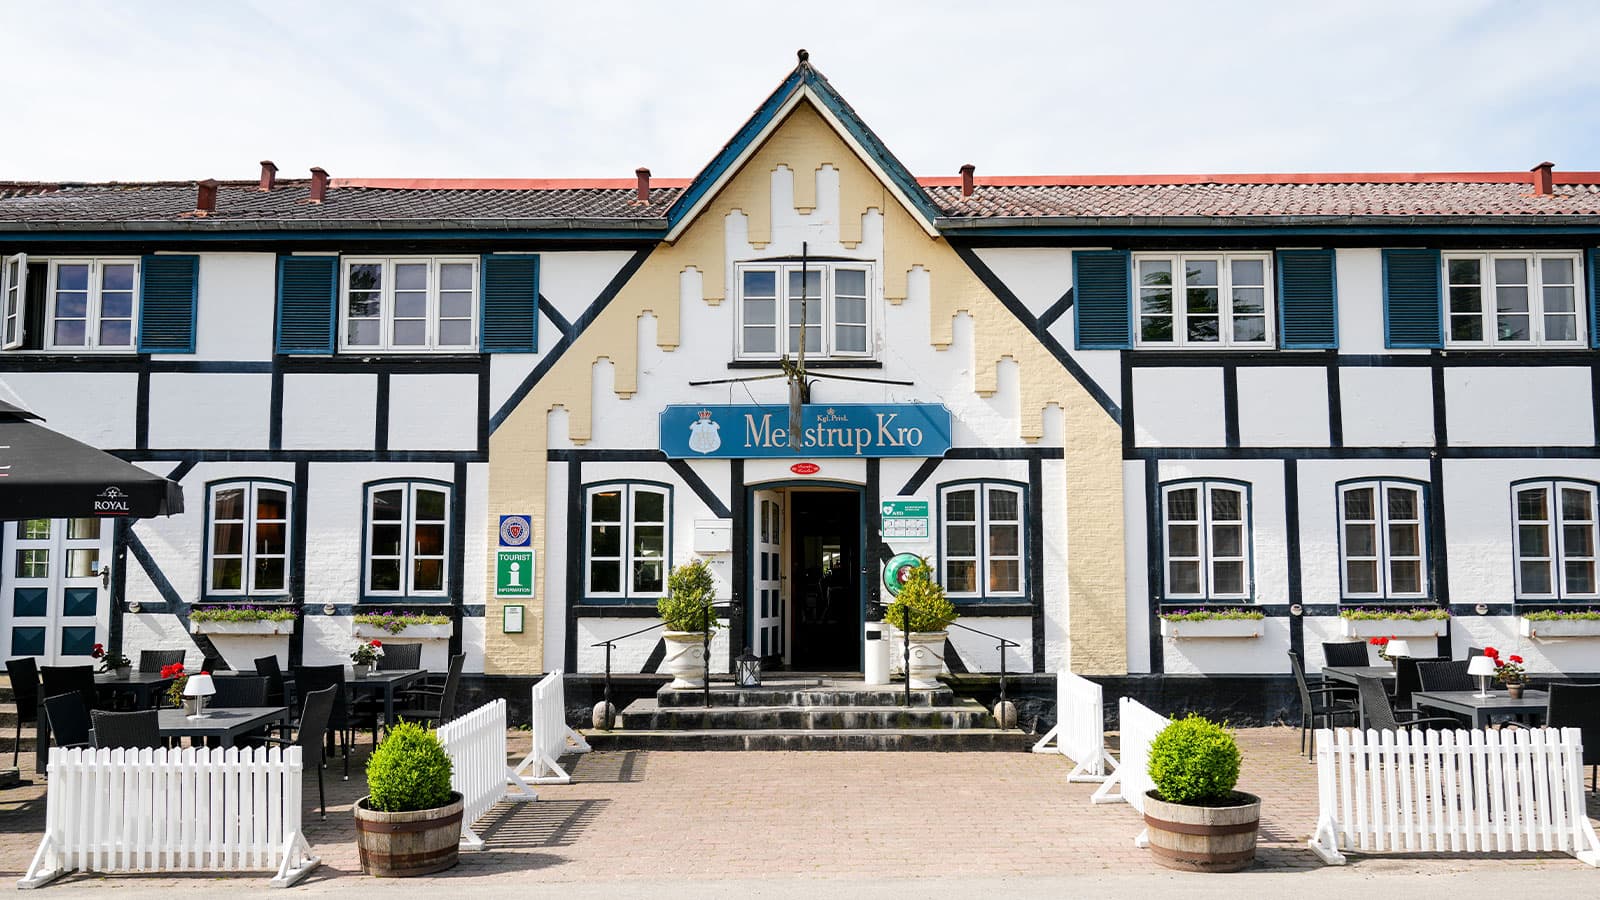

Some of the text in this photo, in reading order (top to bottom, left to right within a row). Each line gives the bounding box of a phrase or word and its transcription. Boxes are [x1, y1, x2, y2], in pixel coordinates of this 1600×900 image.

[744, 413, 923, 455] Mestrup Kro
[94, 500, 130, 511] ROYAL
[499, 553, 531, 561] TOURIST
